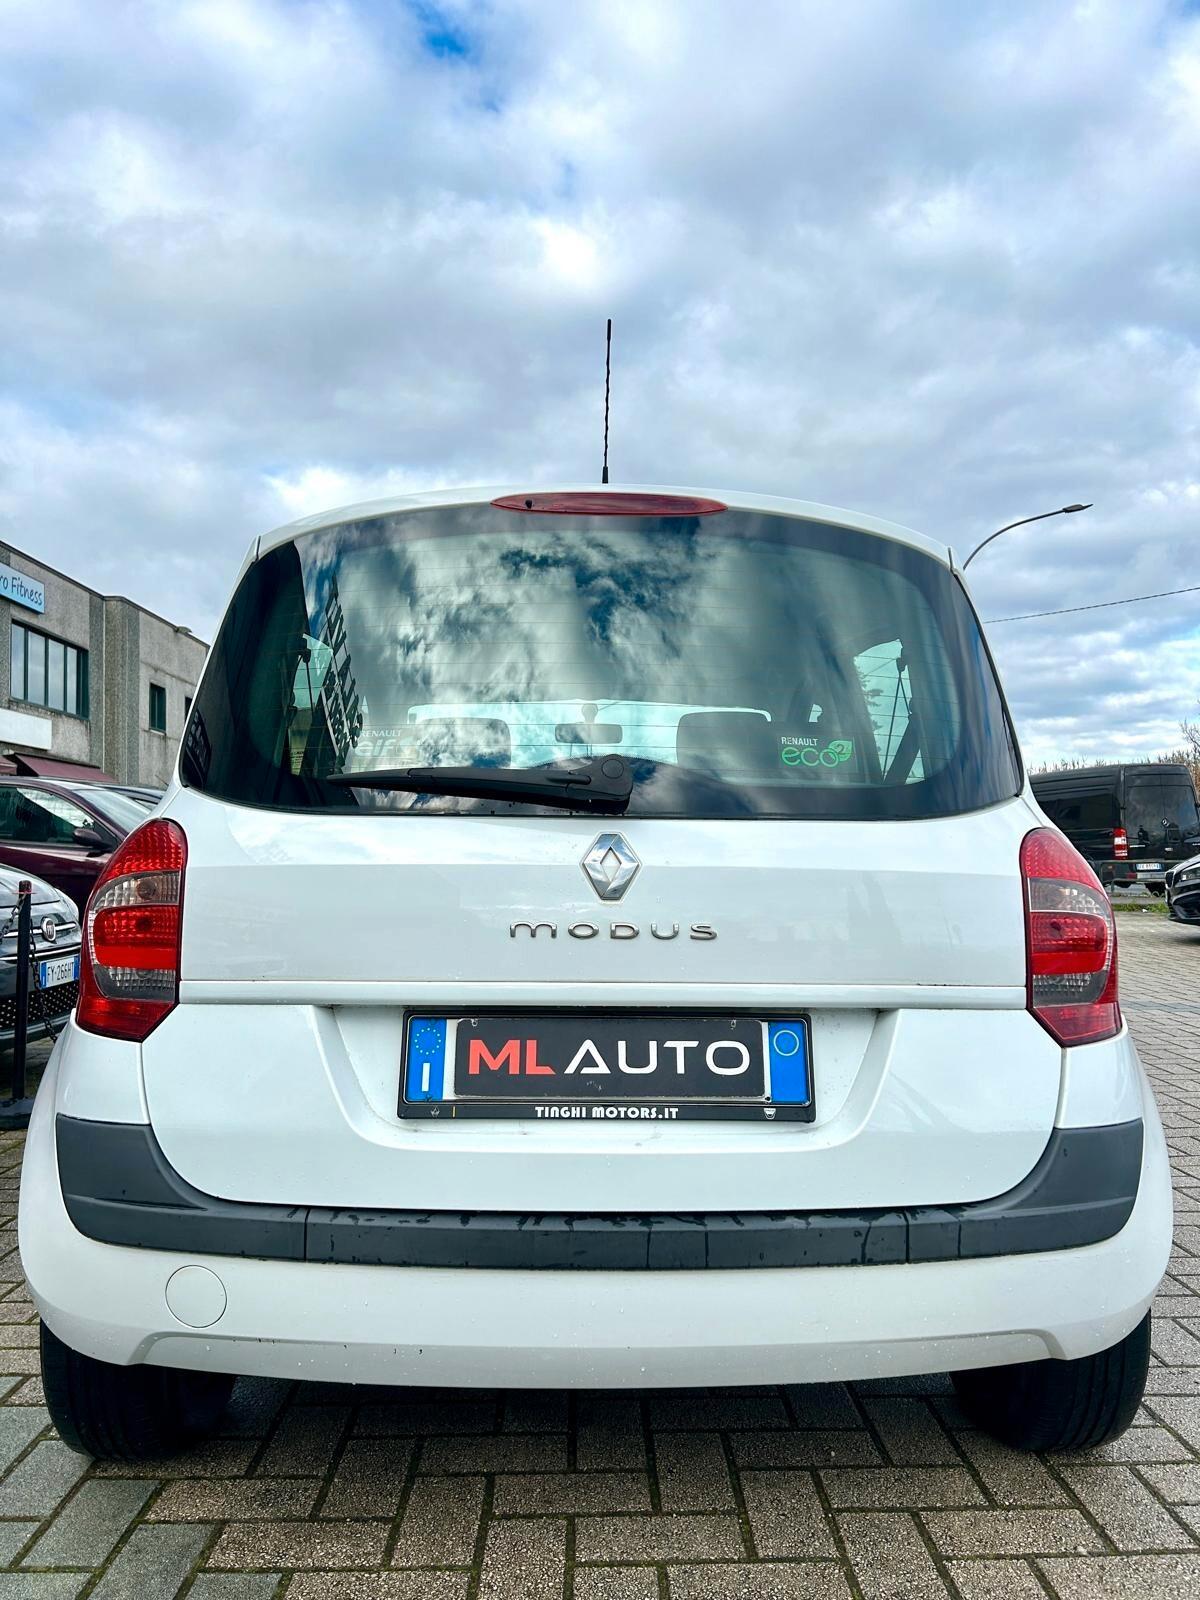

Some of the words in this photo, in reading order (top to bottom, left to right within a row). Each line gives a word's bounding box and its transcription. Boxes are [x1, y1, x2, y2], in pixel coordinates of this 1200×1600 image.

[11, 576, 43, 606] Fitness
[360, 729, 401, 738] RENAULT
[781, 736, 818, 746] RENAULT
[509, 921, 718, 940] MODUS
[534, 1106, 587, 1119] TINGHI
[591, 1106, 679, 1120] MOTORS.IT
